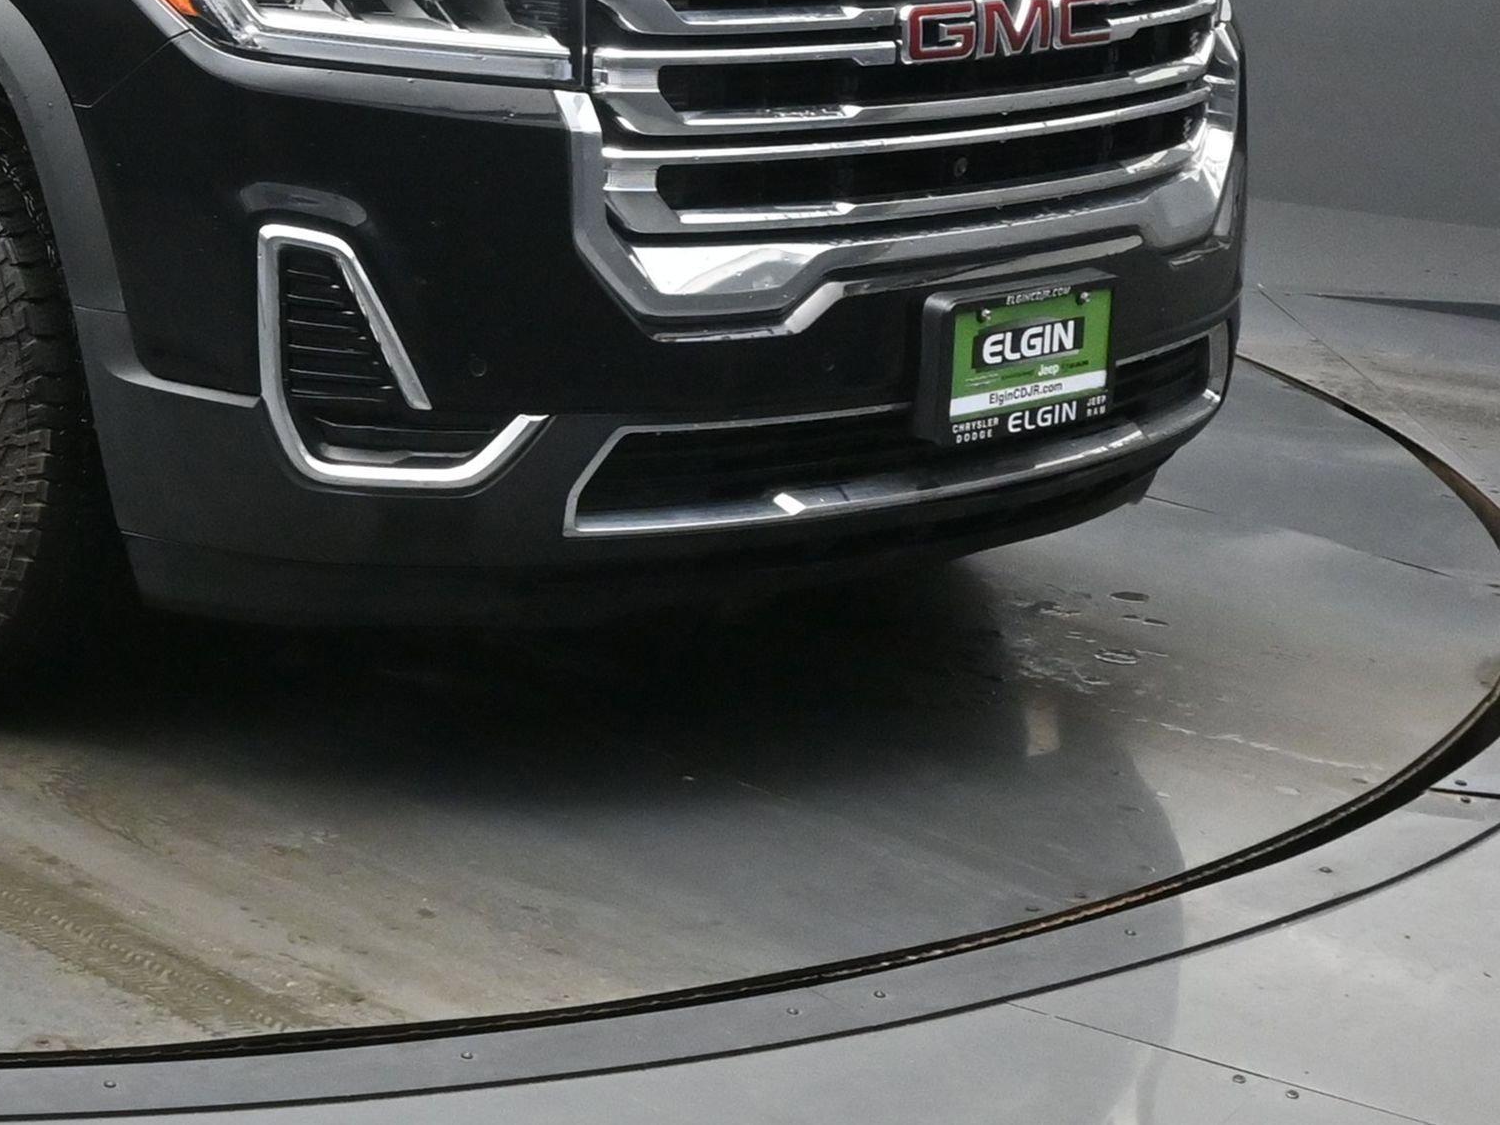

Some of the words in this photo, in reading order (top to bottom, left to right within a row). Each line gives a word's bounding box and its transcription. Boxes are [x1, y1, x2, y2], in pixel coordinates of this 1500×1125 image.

[982, 320, 1075, 365] ELGIN
[1038, 363, 1060, 377] Jeep
[988, 382, 1063, 406] ElginCDJR.com
[1086, 394, 1107, 407] JEEP
[952, 417, 999, 434] CHRYSLER
[1007, 401, 1077, 433] ELGIN
[956, 428, 993, 444] DODGE
